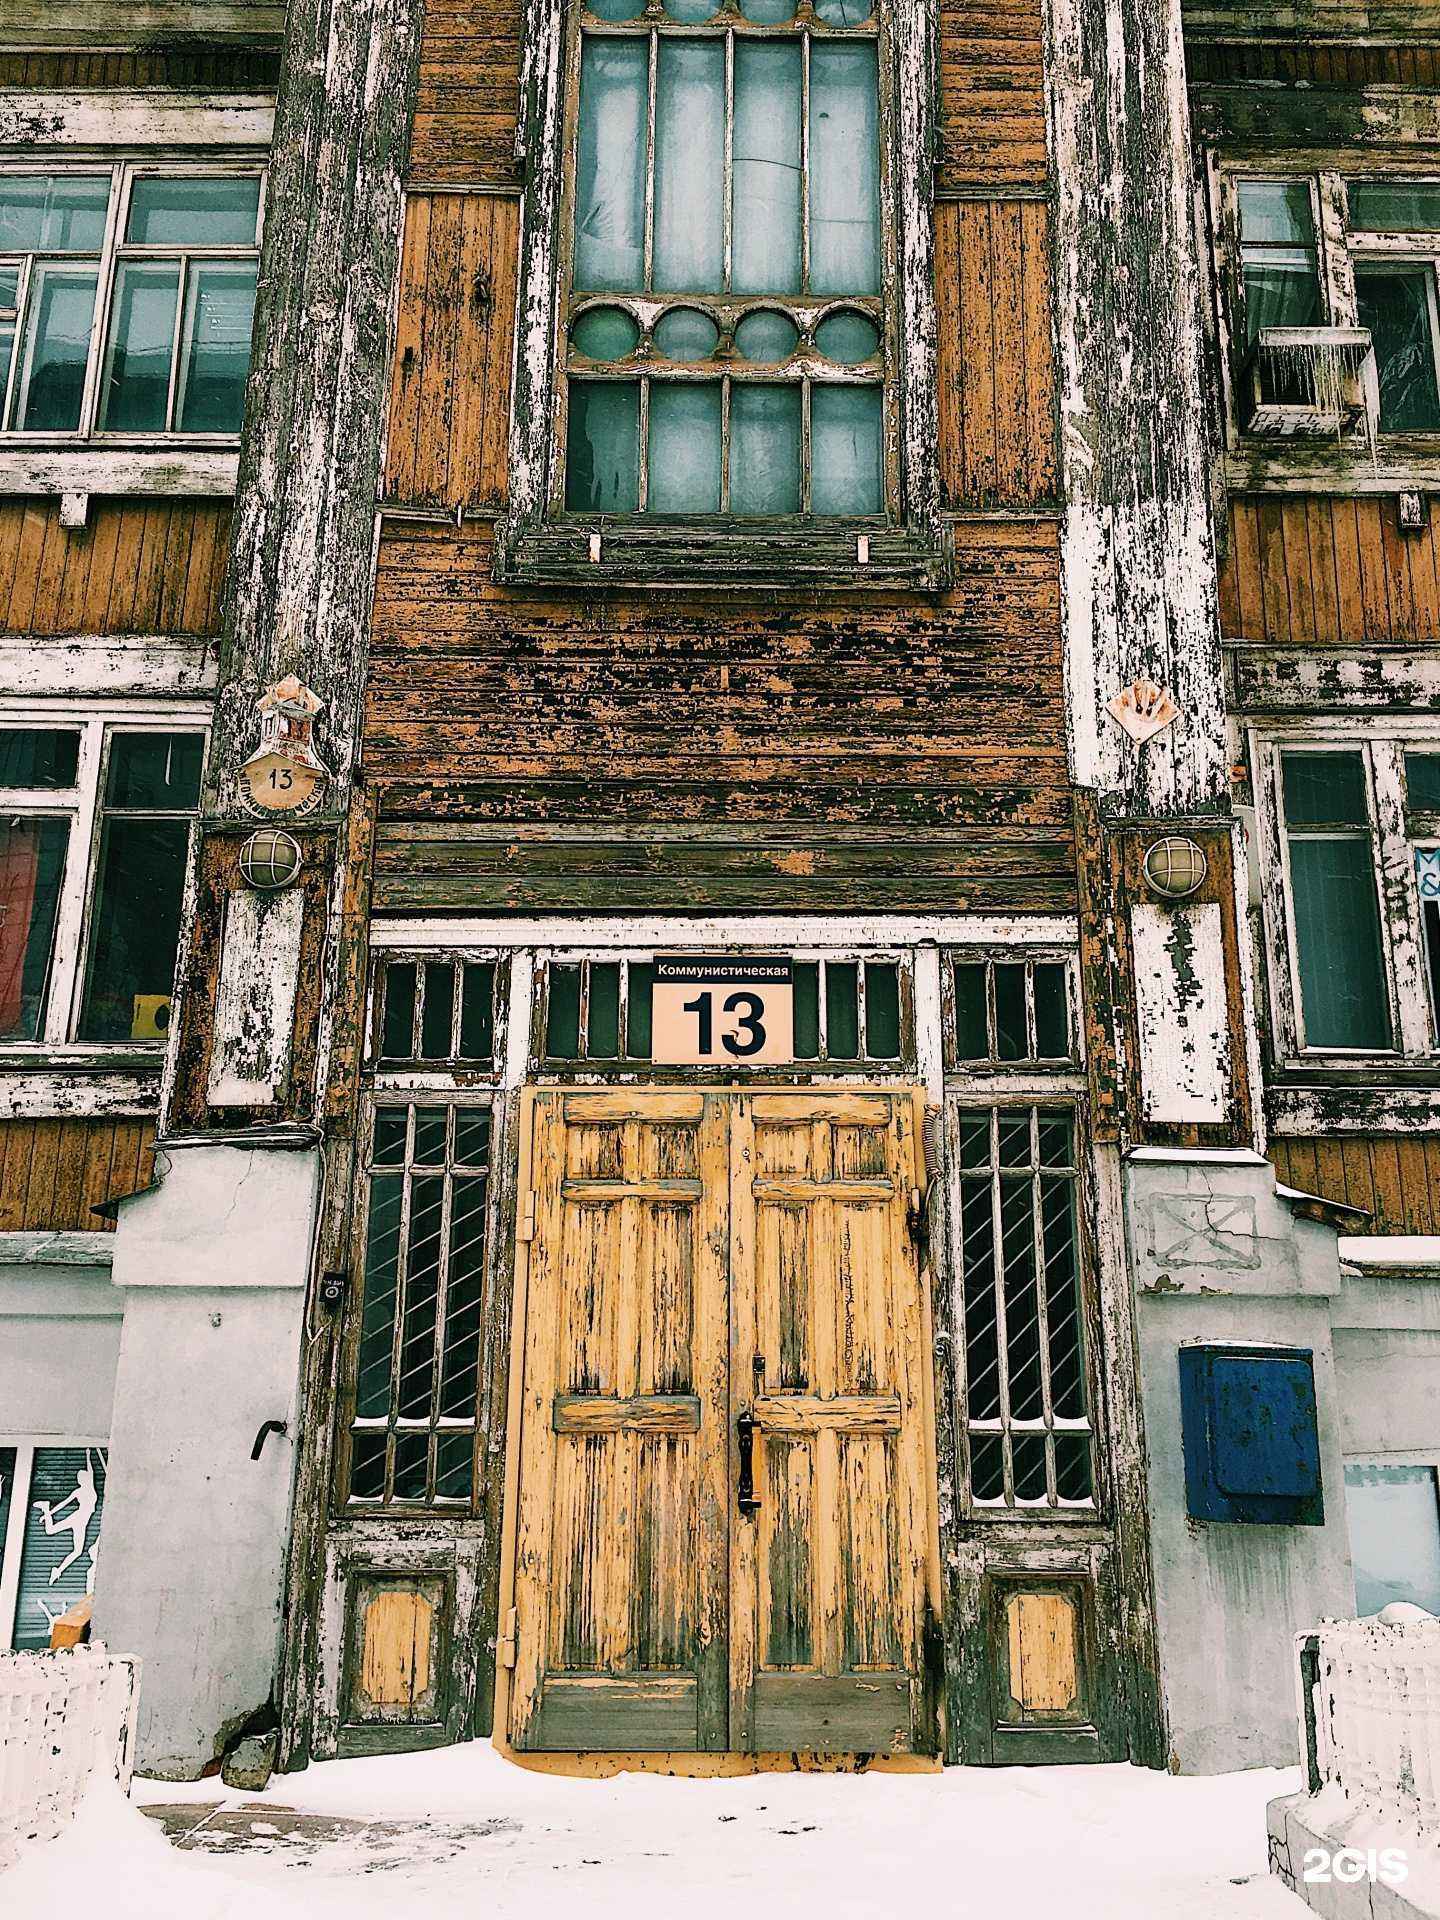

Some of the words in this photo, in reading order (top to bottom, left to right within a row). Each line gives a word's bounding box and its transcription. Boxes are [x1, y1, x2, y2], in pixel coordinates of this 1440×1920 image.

[269, 768, 293, 790] 13
[658, 964, 789, 978] Коммунистическая
[683, 991, 767, 1057] 13
